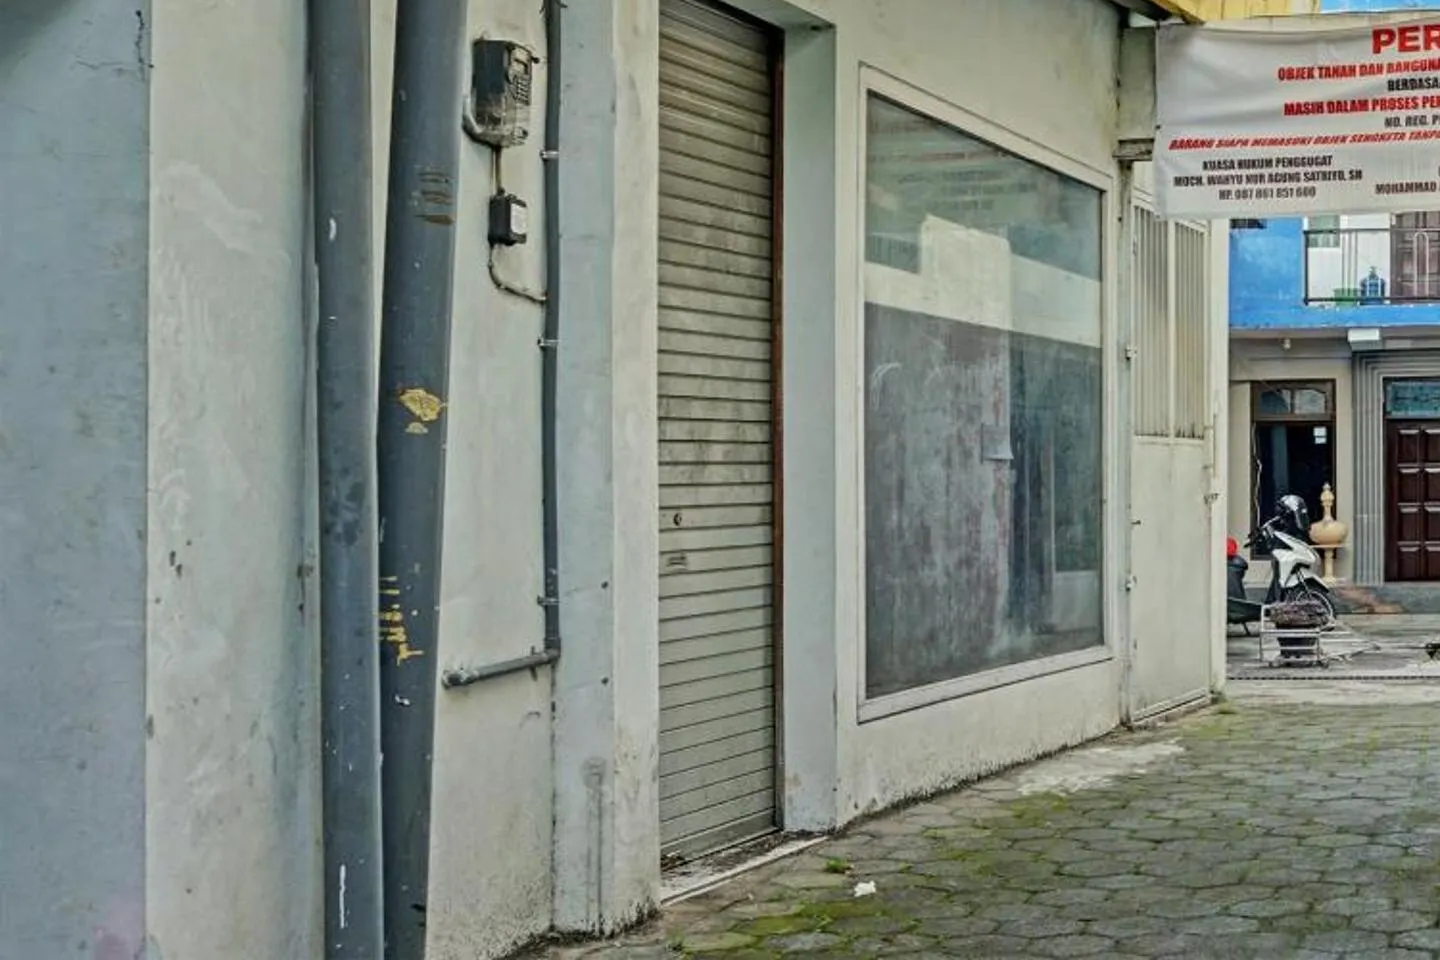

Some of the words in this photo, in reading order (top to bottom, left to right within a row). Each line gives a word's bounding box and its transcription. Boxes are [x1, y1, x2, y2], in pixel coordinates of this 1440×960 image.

[1278, 66, 1315, 81] OBJEK
[1317, 63, 1357, 79] TANAH
[1360, 62, 1385, 77] DAN
[1284, 100, 1325, 117] MASIH
[1327, 98, 1370, 115] DALAM
[1371, 95, 1420, 113] PROSES
[1168, 139, 1214, 150] BARANG
[1250, 136, 1311, 147] MEMASUKI
[1312, 134, 1347, 145] OBJEK
[1349, 131, 1406, 143] SENGKETA
[1203, 159, 1236, 171] KUASA
[1237, 158, 1274, 170] HUKUM
[1274, 155, 1334, 169] PENGGUGAT
[1207, 173, 1244, 186] WAHYU
[1267, 171, 1301, 183] AGUNG
[1375, 180, 1438, 195] MOHAMMAD
